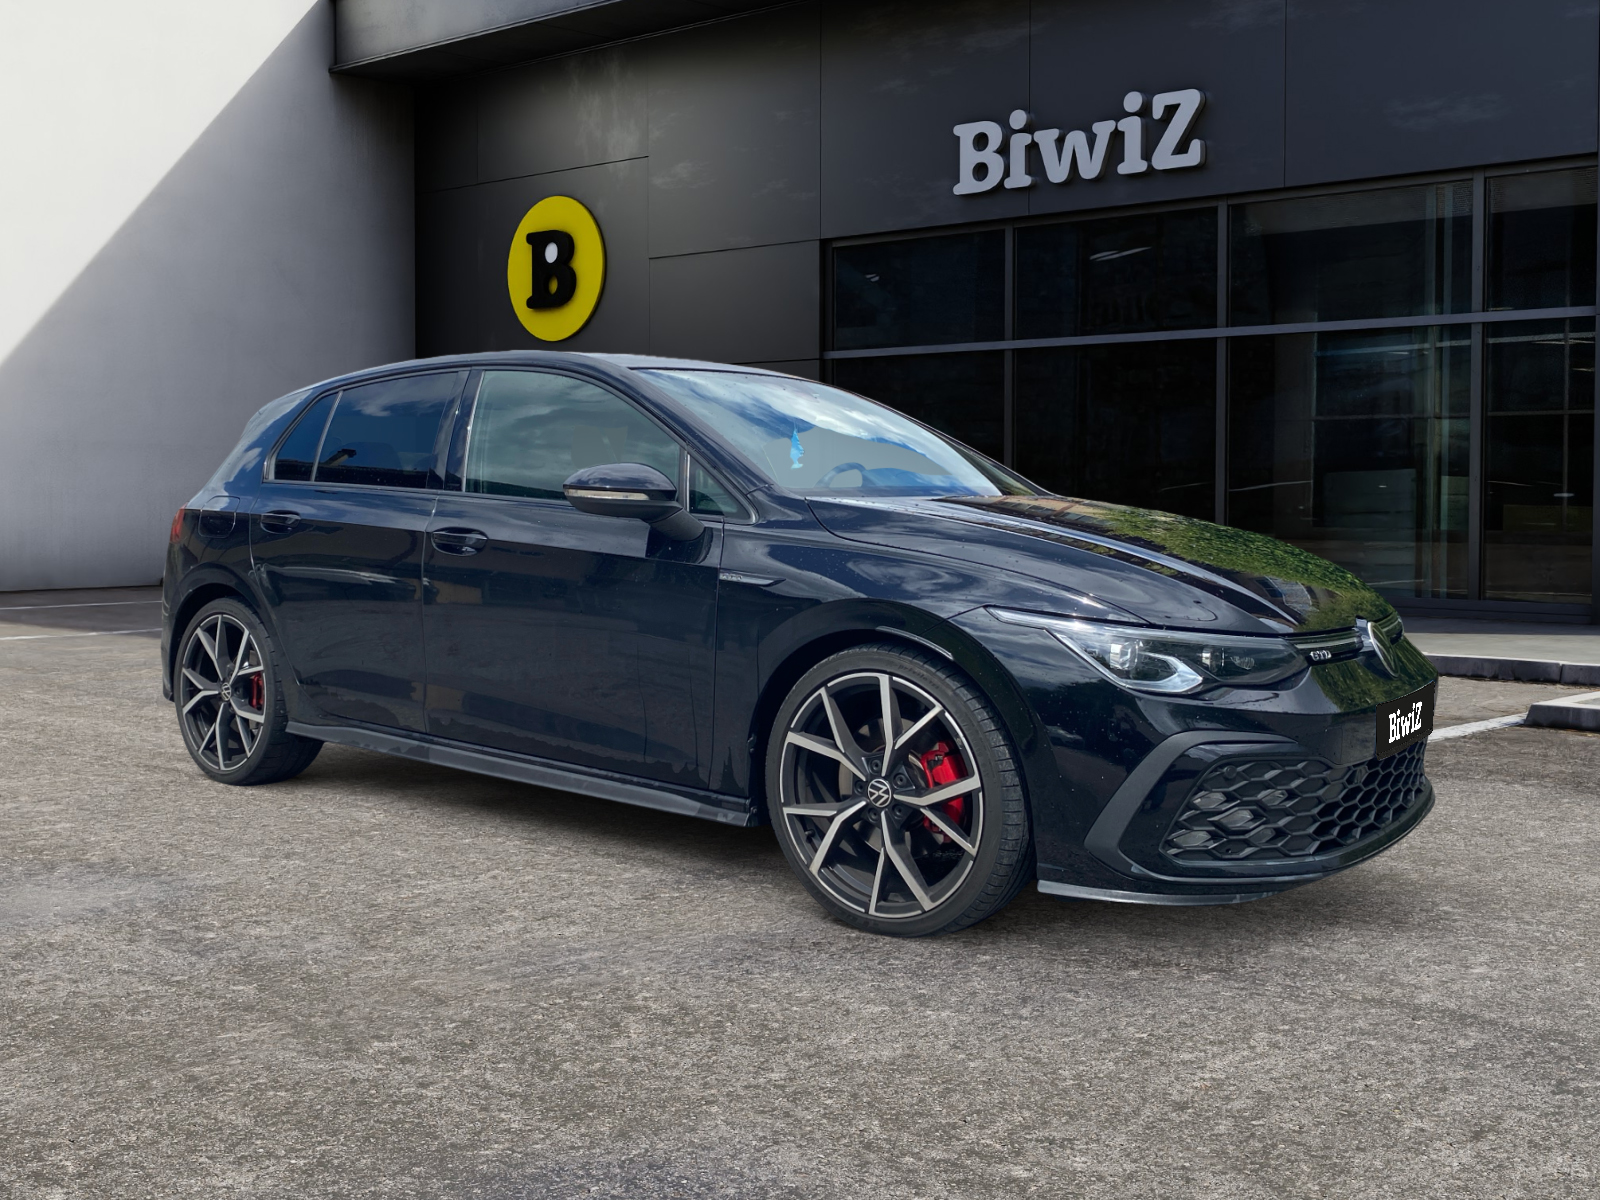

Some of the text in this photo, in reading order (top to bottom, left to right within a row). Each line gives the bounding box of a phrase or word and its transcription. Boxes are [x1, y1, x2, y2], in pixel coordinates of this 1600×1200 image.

[953, 89, 1205, 195] BiwiZ
[526, 230, 576, 309] B
[1388, 701, 1423, 743] BiwiZ
